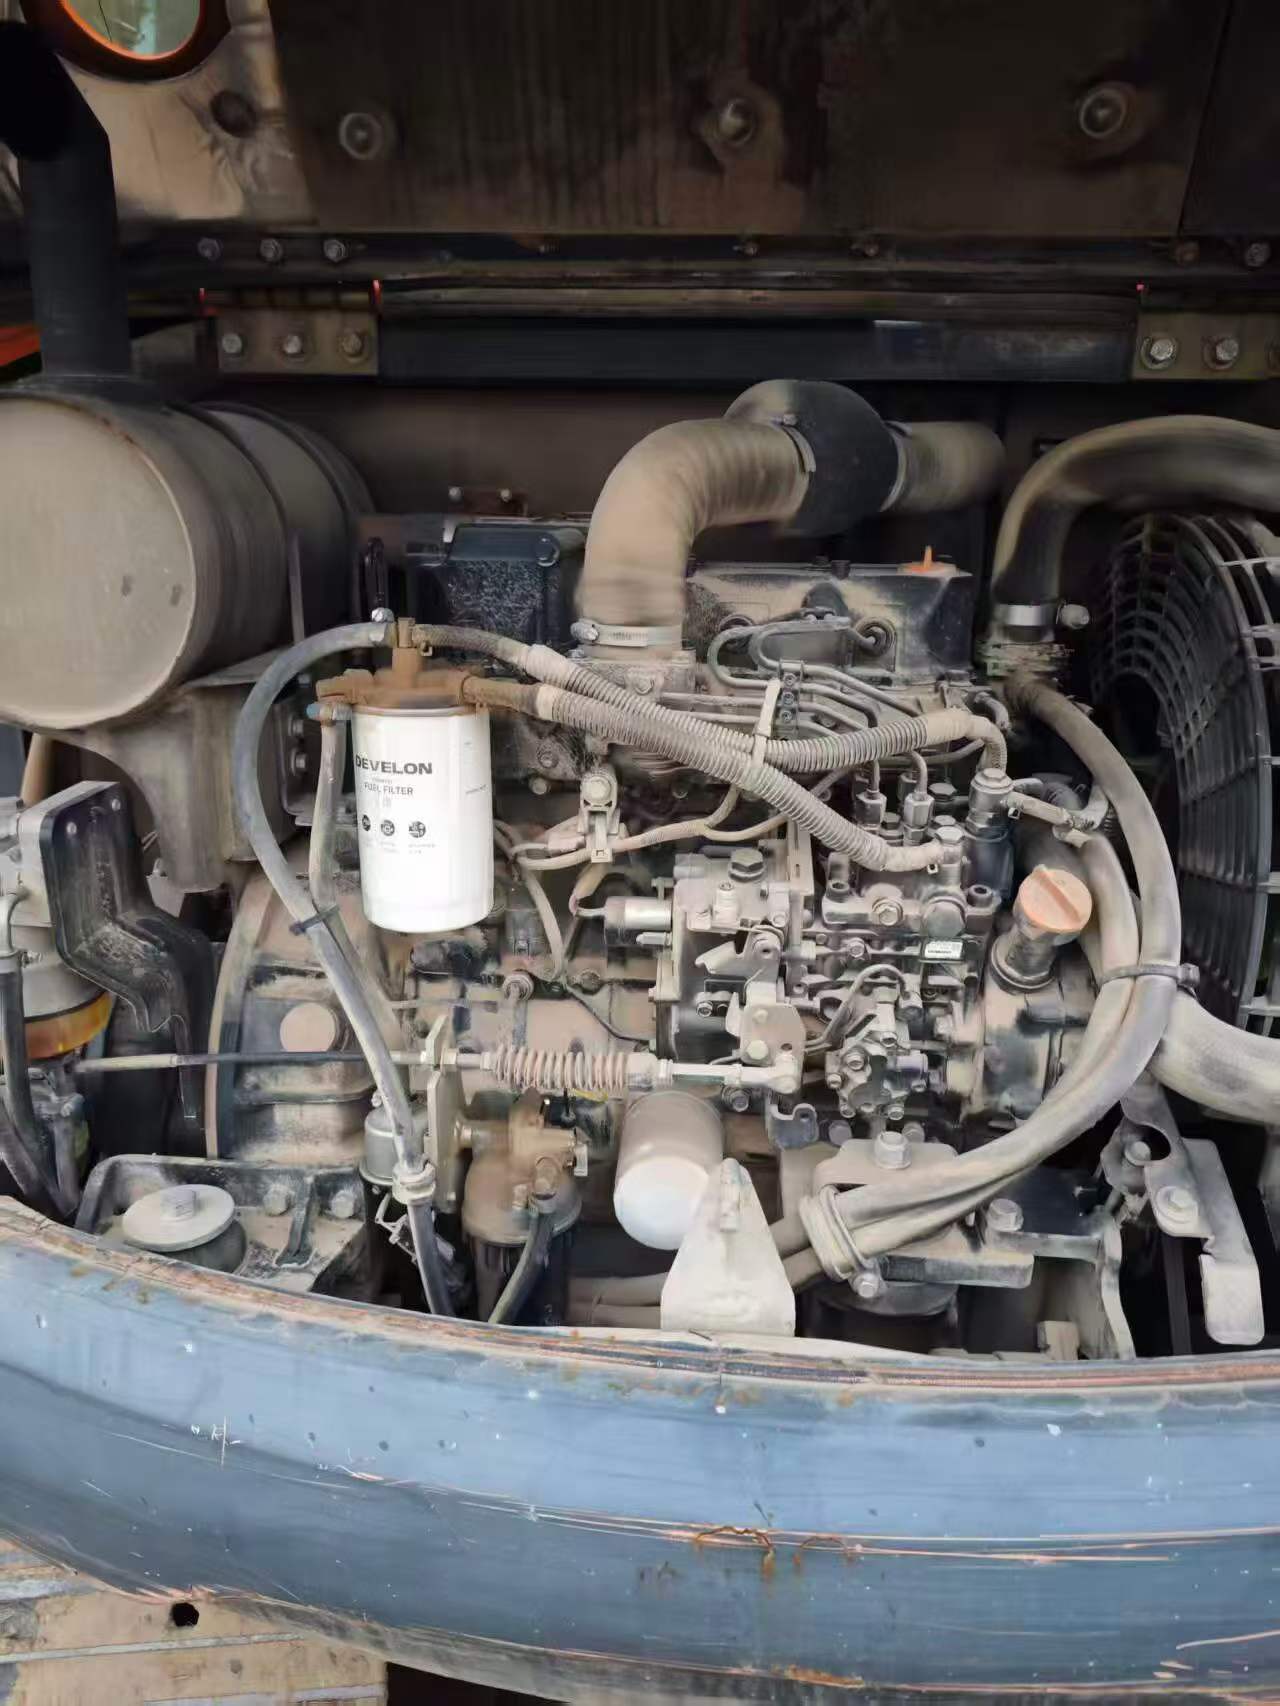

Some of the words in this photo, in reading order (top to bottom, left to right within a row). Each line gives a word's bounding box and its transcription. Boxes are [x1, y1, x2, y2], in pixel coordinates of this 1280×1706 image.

[355, 754, 433, 775] DEVELON
[364, 782, 381, 793] FUEL
[383, 784, 414, 796] FILTER
